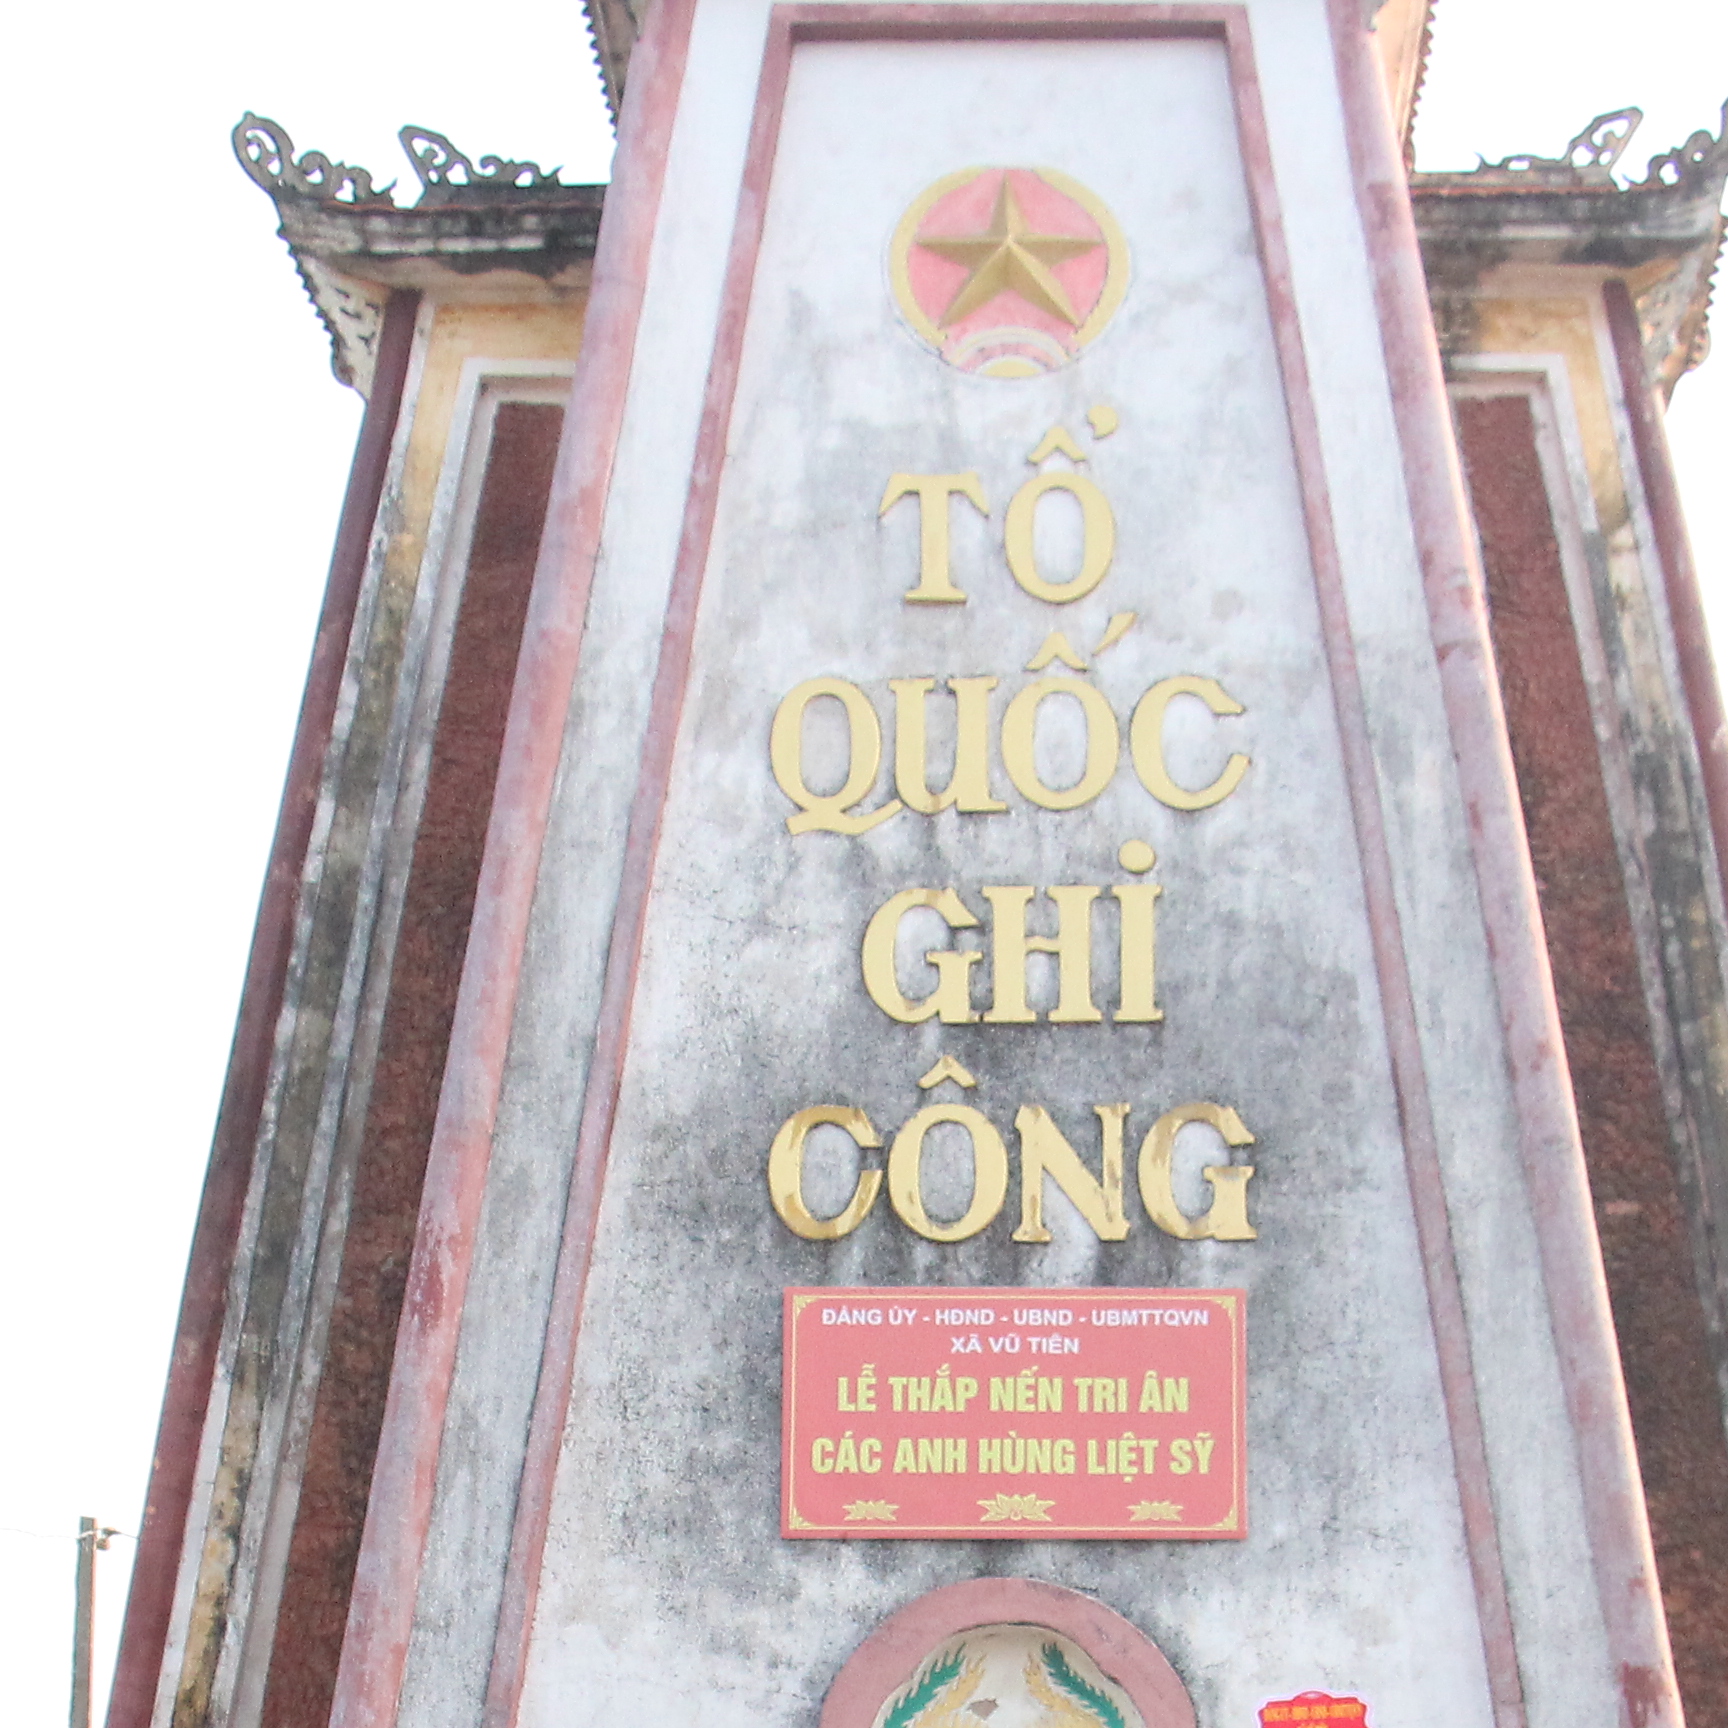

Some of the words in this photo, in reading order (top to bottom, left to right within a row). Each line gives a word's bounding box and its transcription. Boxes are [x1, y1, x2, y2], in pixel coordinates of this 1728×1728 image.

[878, 405, 1119, 604] TỔ
[770, 612, 1252, 836] QUỐC
[768, 1054, 1257, 1243] CÔNG
[821, 1305, 883, 1326] ĐẢNG
[934, 1308, 995, 1326] HĐND
[1013, 1308, 1073, 1326] UBND
[1091, 1308, 1209, 1327] UBMTTQVN
[950, 1333, 983, 1354] XÃ
[987, 1332, 1021, 1354] VŨ
[837, 1362, 877, 1413] LỄ
[887, 1362, 979, 1413] THẮP
[989, 1365, 1064, 1413] NẾN
[1073, 1377, 1129, 1413] TRI
[1138, 1370, 1190, 1413] ÂN
[811, 1430, 882, 1474] CÁC
[892, 1438, 968, 1474] ANH
[978, 1430, 1077, 1475] HÙNG
[1087, 1431, 1160, 1483] LIỆT
[1169, 1432, 1215, 1475] SỸ
